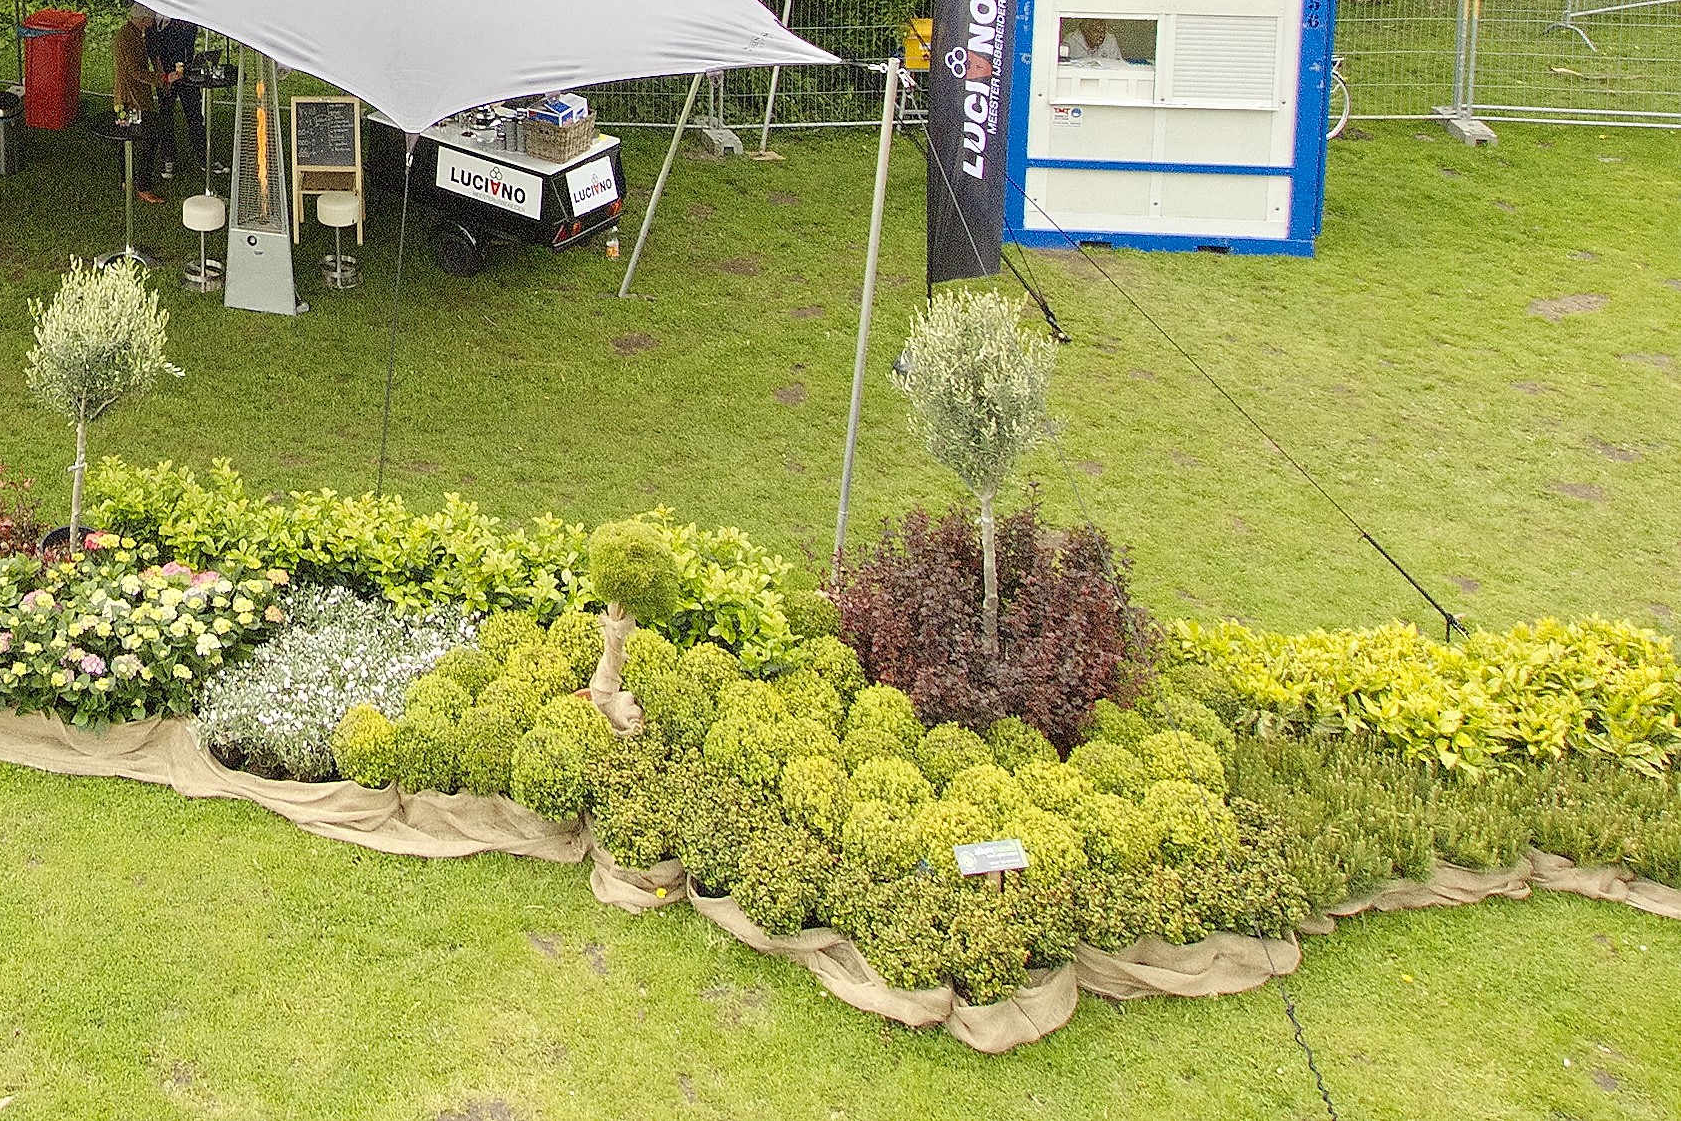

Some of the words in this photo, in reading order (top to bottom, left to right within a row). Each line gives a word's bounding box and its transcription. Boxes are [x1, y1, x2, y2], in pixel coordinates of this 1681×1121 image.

[987, 78, 1001, 135] MEESTER
[450, 167, 526, 204] LUCIANO
[573, 178, 613, 204] LUCIANO
